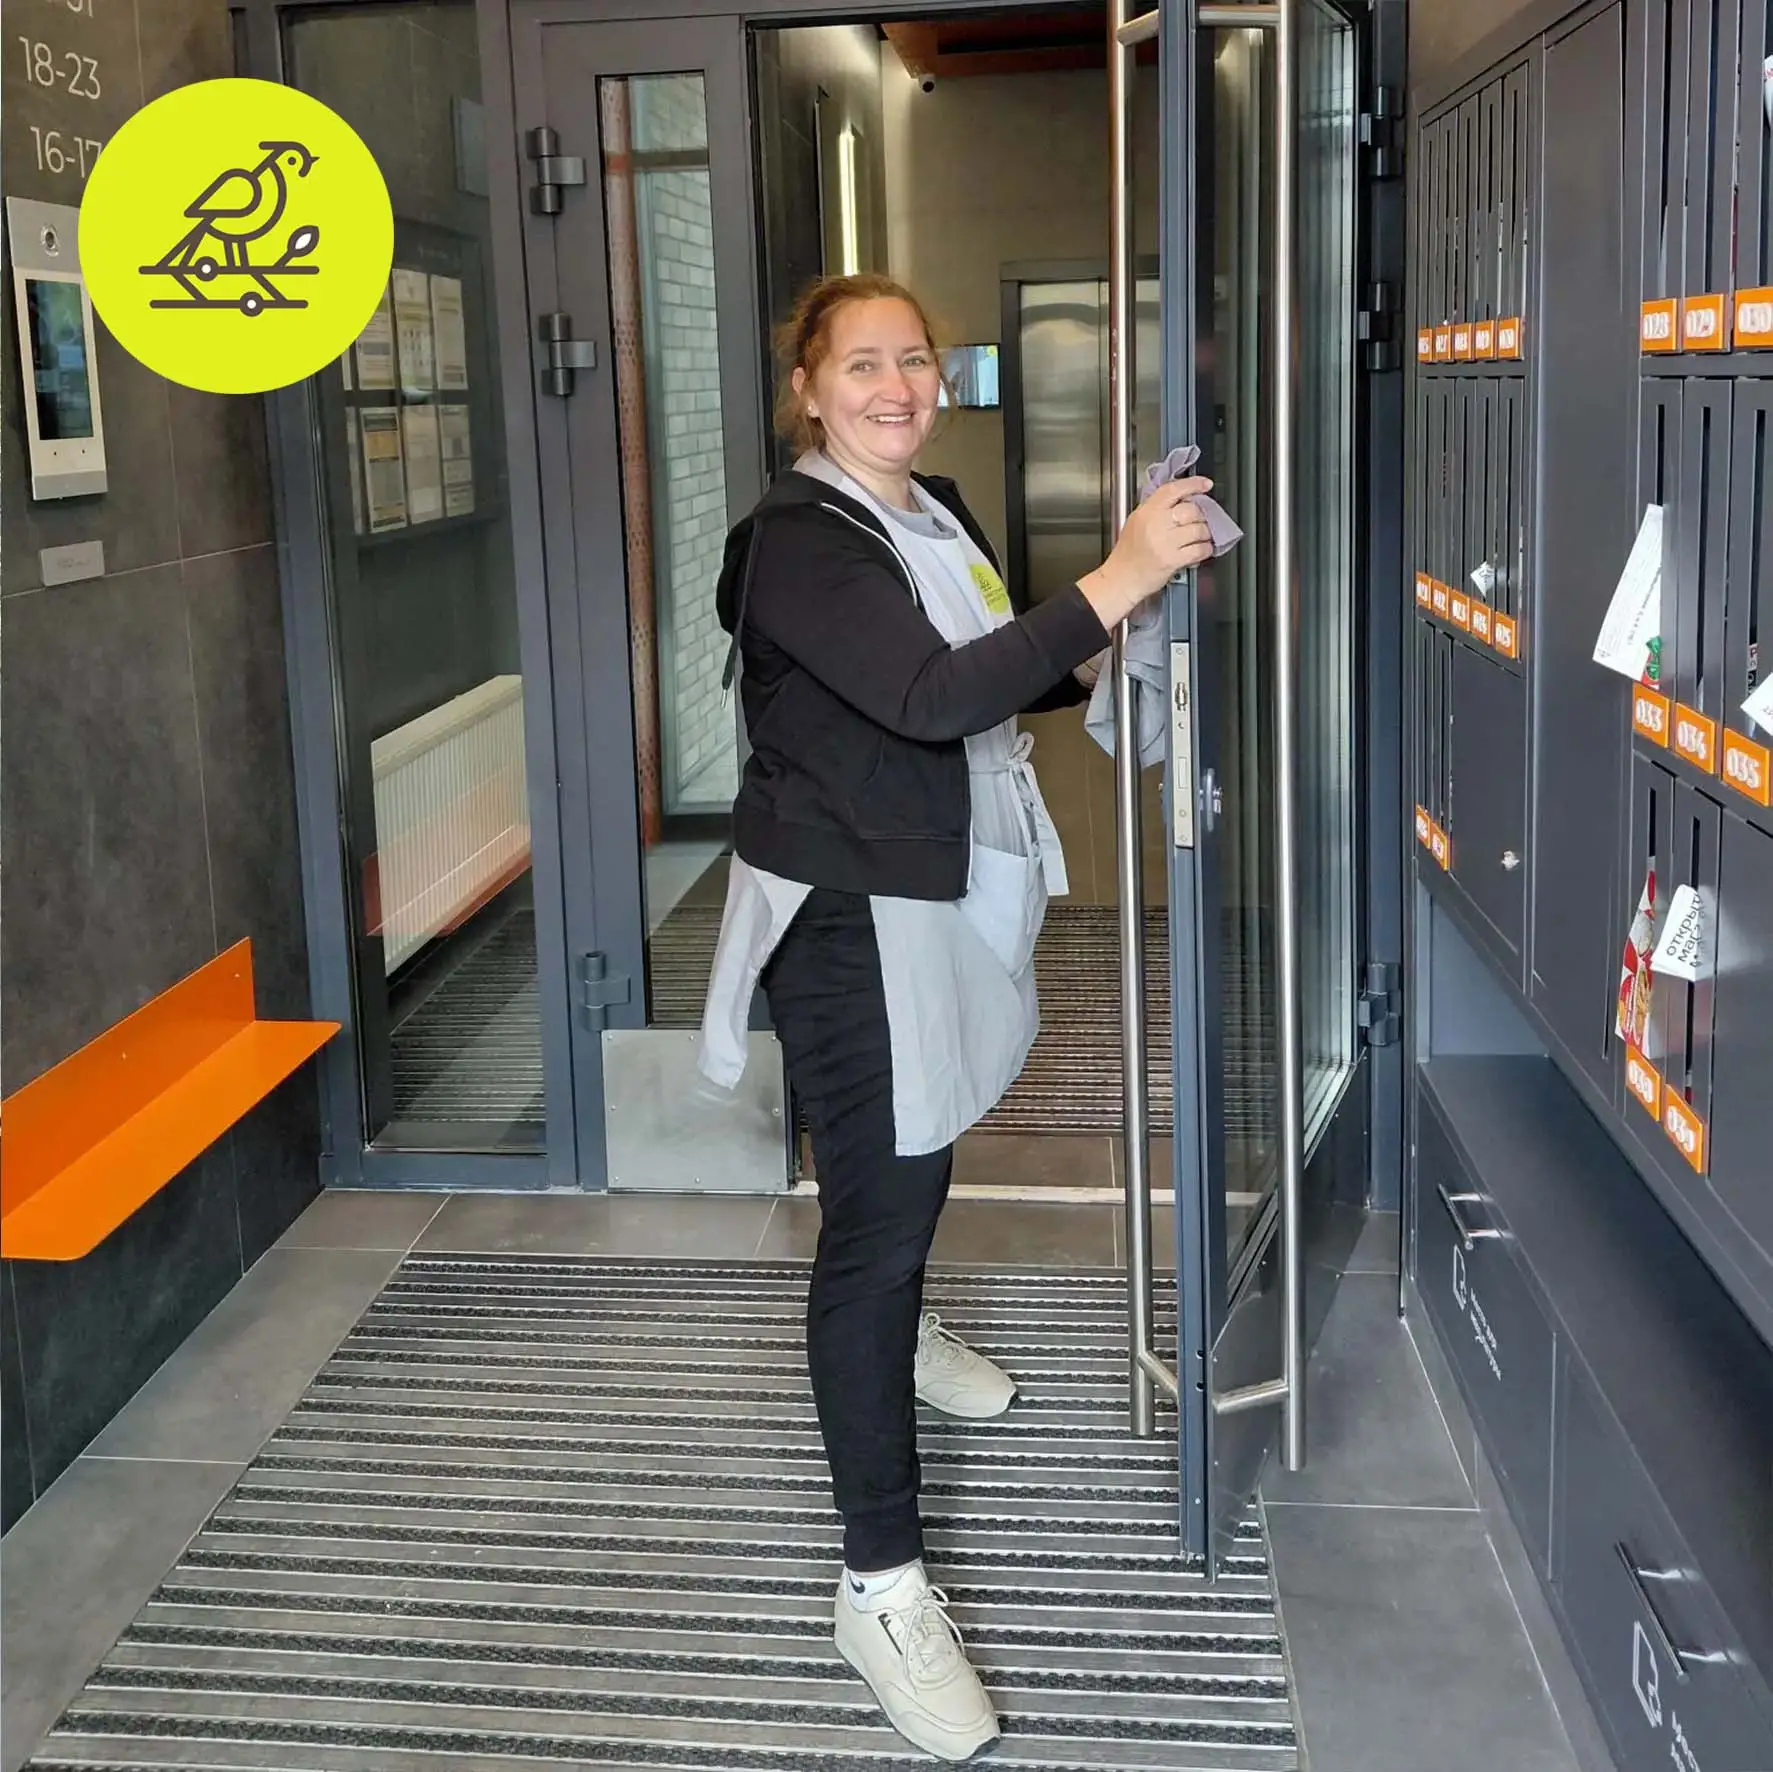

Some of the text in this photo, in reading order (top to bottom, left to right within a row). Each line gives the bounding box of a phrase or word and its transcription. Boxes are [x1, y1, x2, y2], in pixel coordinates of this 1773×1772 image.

[19, 36, 100, 99] 18-23
[30, 126, 102, 178] 16-17
[1686, 309, 1715, 337] 029
[1635, 698, 1663, 732] 033
[1678, 721, 1706, 760] 034
[1726, 748, 1760, 789] 035
